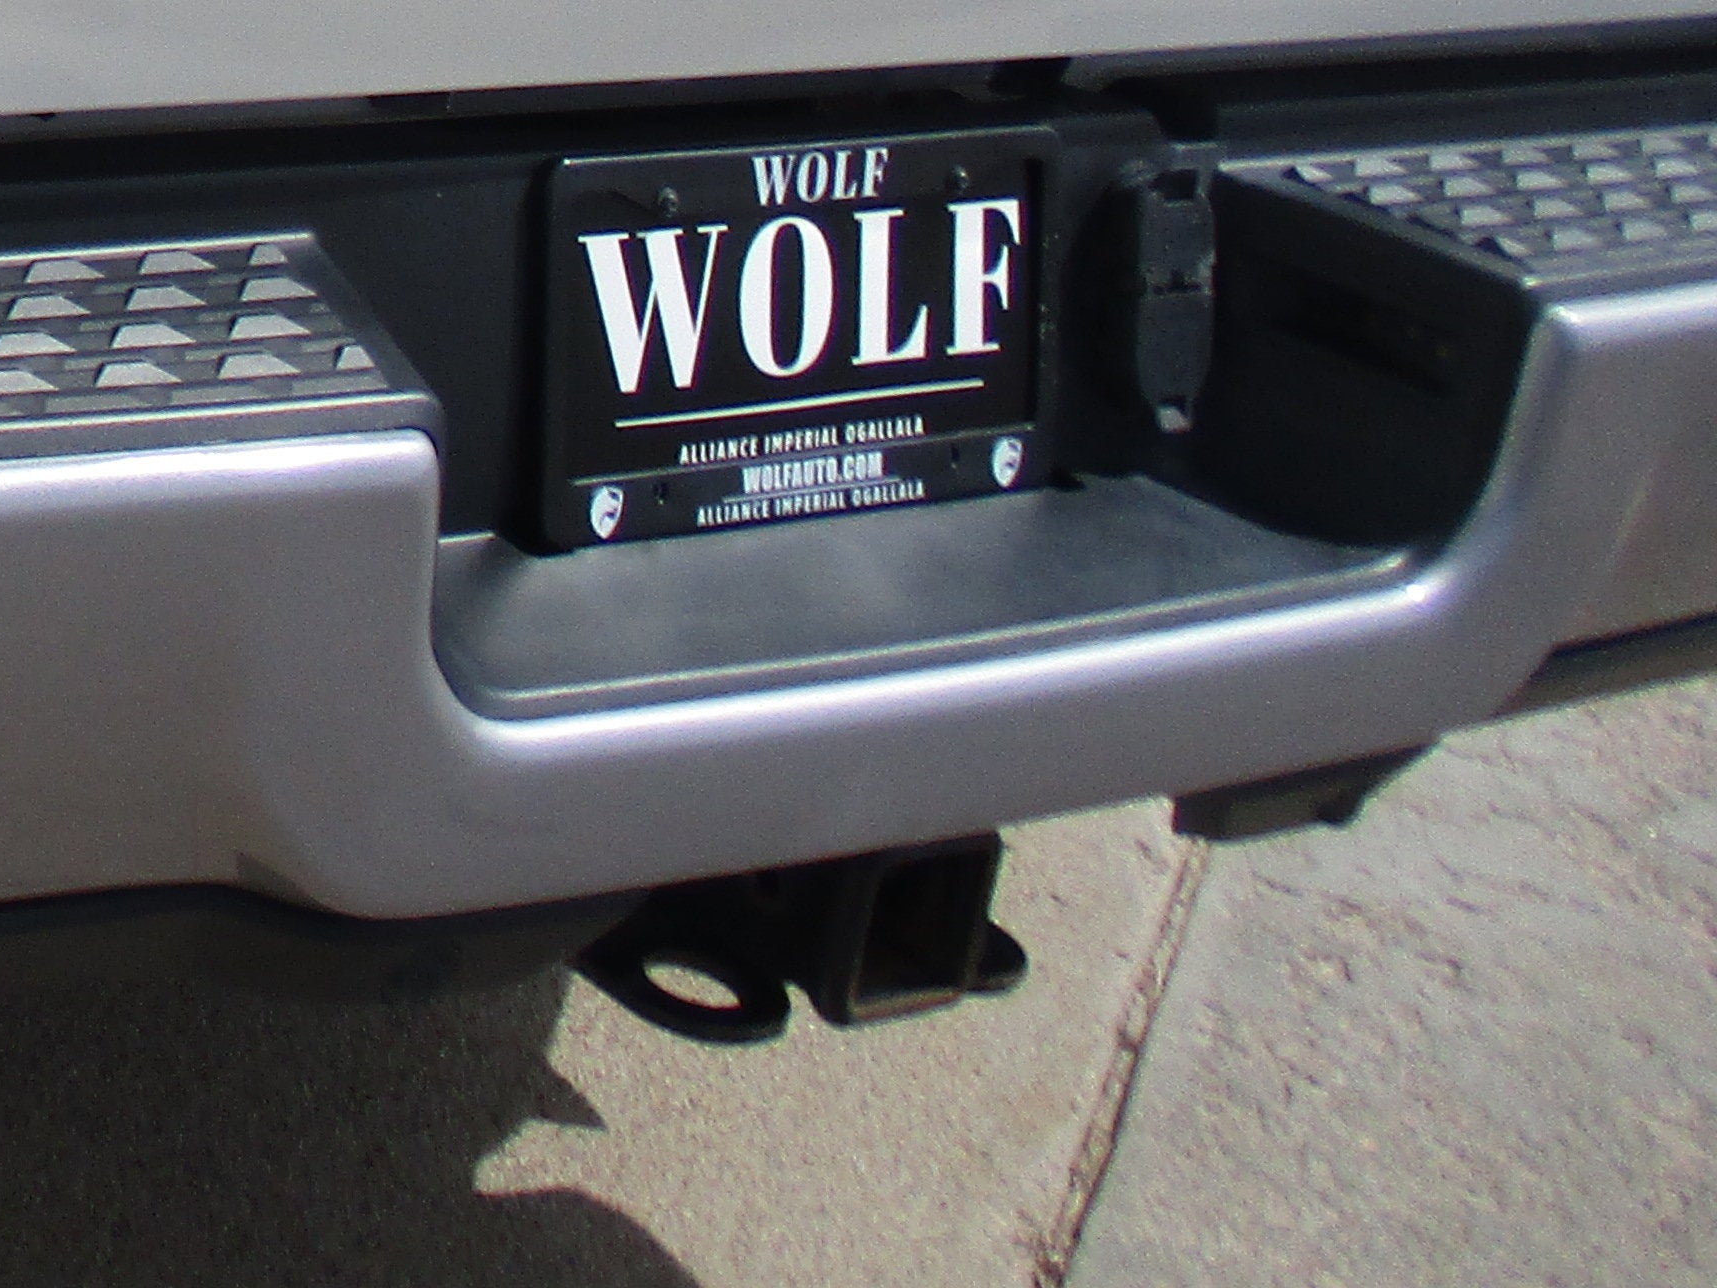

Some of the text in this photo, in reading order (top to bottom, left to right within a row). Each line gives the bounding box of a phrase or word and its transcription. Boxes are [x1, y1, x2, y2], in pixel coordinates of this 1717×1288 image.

[752, 147, 890, 206] WOLF
[577, 198, 1022, 395] WOLF
[679, 415, 926, 465] ALLIANCE IMPERIAL OGALLALA
[743, 451, 883, 493] WOLFAUTO.COM
[696, 479, 925, 527] ALLIANCE IMPERIAL OGALLALA
